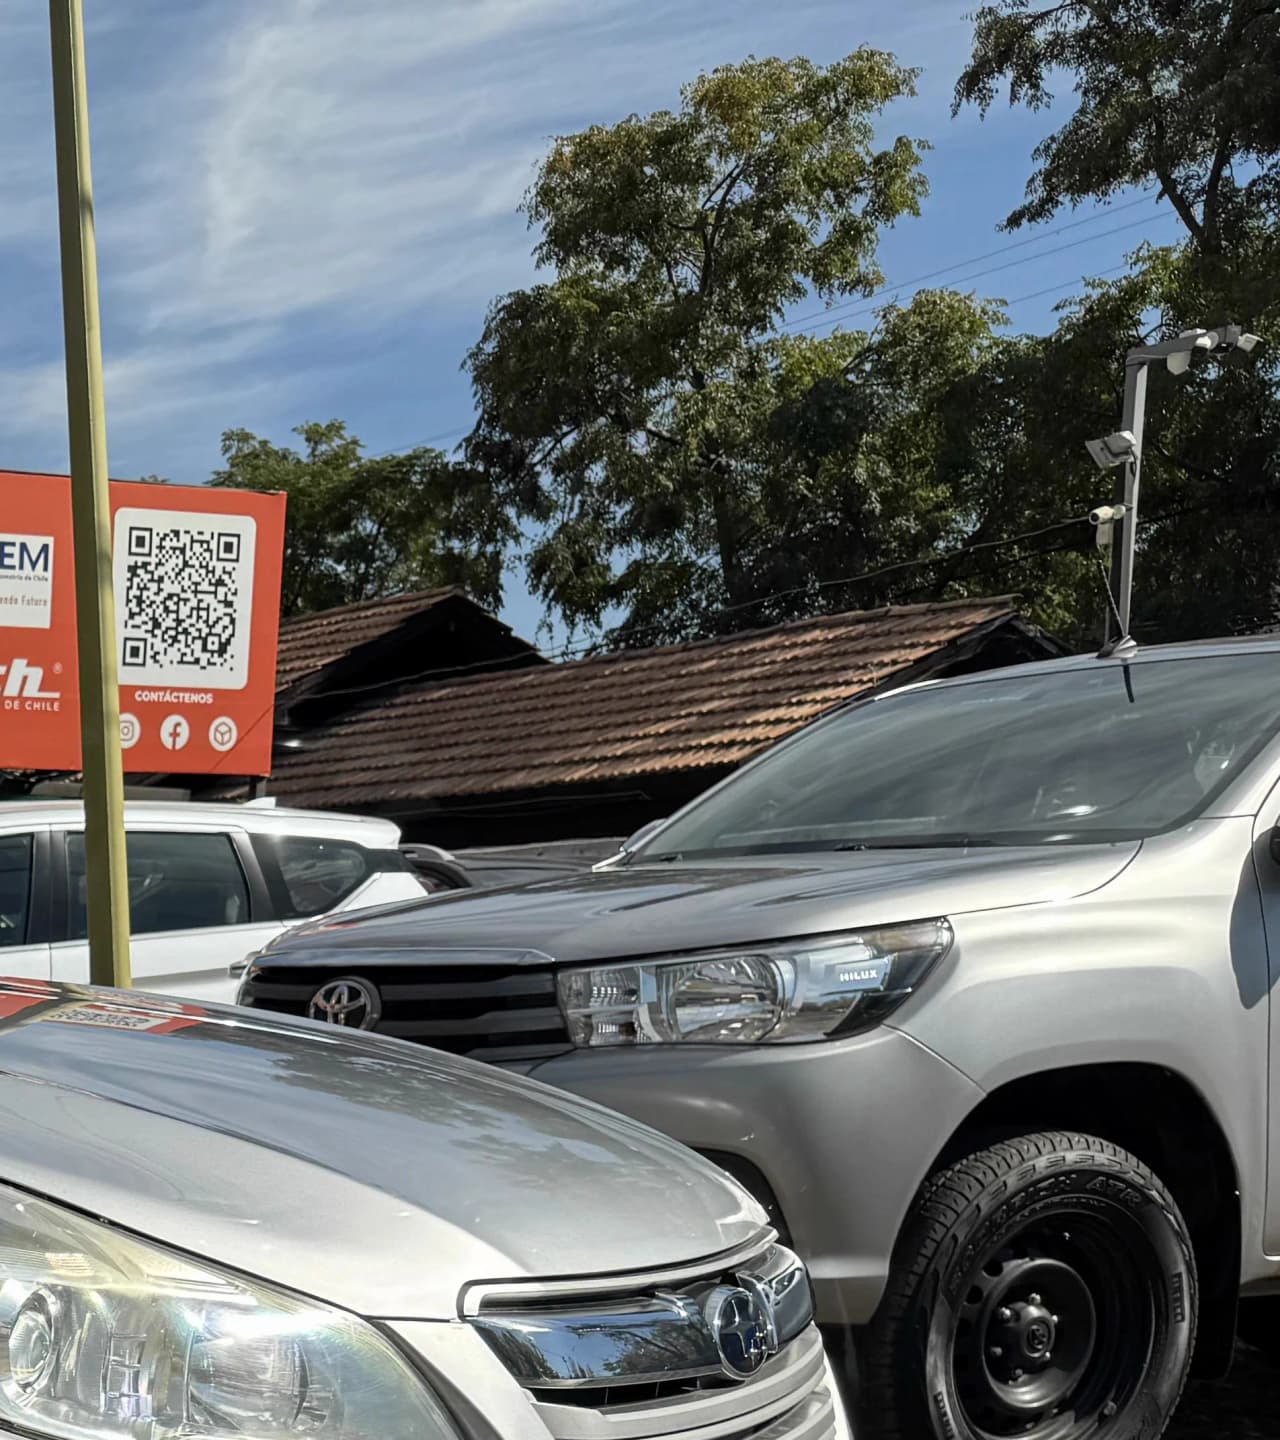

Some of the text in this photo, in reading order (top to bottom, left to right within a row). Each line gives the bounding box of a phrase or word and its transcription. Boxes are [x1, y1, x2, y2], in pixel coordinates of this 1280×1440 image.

[134, 689, 214, 704] CONTÁCTENOS
[4, 700, 20, 710] DE
[24, 701, 61, 712] CHILE
[839, 969, 878, 982] HILUX
